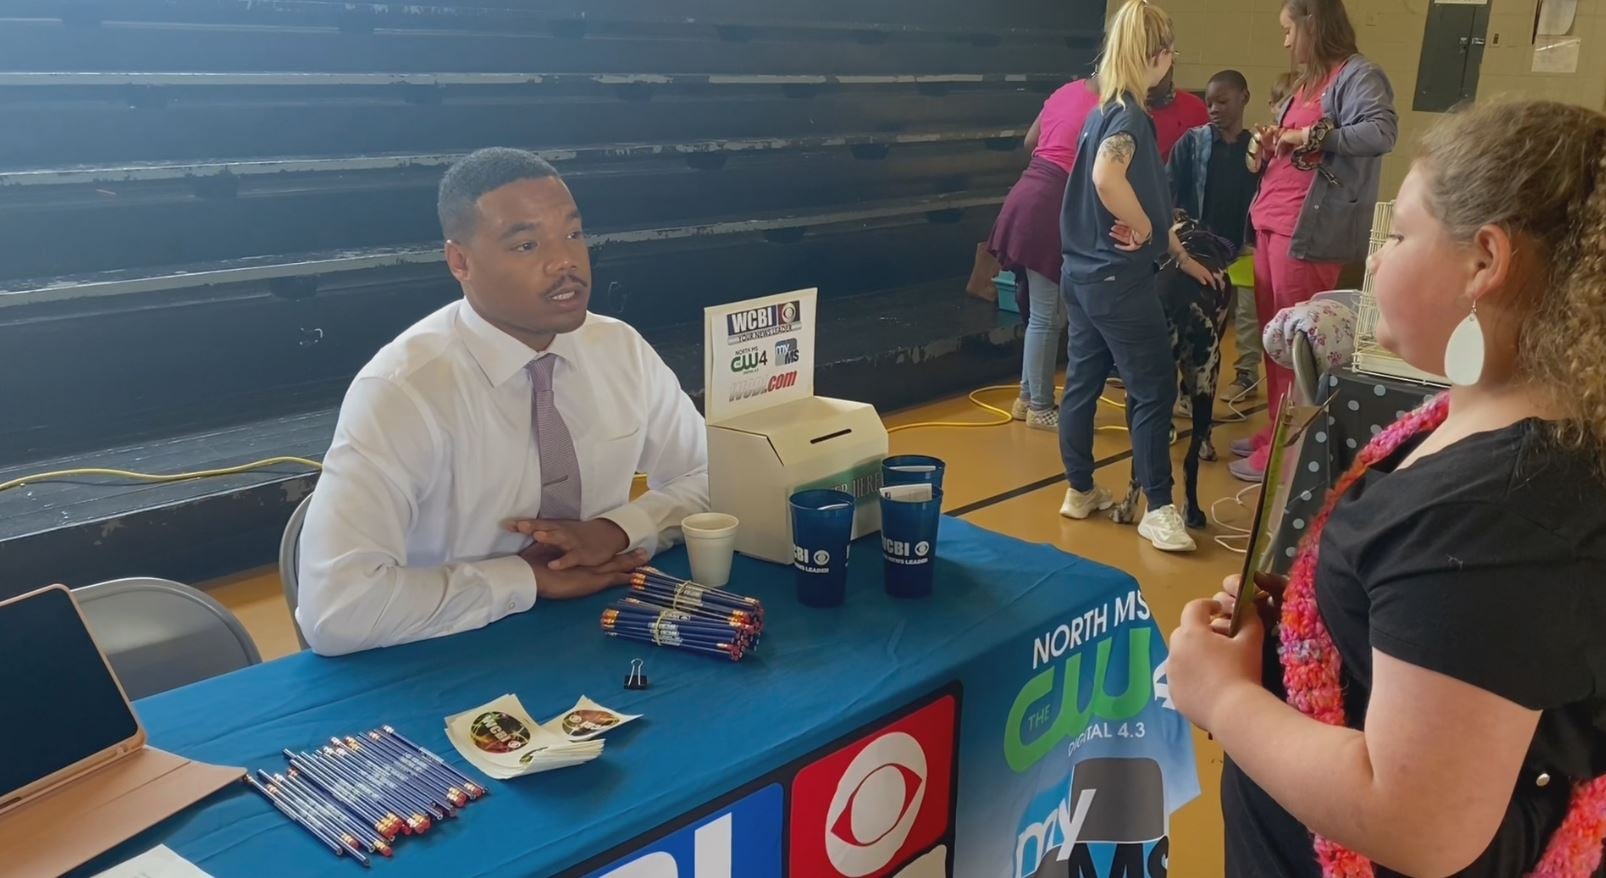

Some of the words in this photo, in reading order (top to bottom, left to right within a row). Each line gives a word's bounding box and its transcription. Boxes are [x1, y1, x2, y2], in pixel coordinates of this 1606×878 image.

[731, 307, 773, 333] WCBI
[731, 352, 758, 372] CW
[759, 349, 768, 366] 4
[1032, 604, 1107, 669] NORTH
[1114, 590, 1151, 627] MS
[1004, 627, 1152, 774] CW
[1028, 704, 1050, 731] THE
[1068, 722, 1112, 757] DIGITAL
[1118, 722, 1146, 738] 4.3
